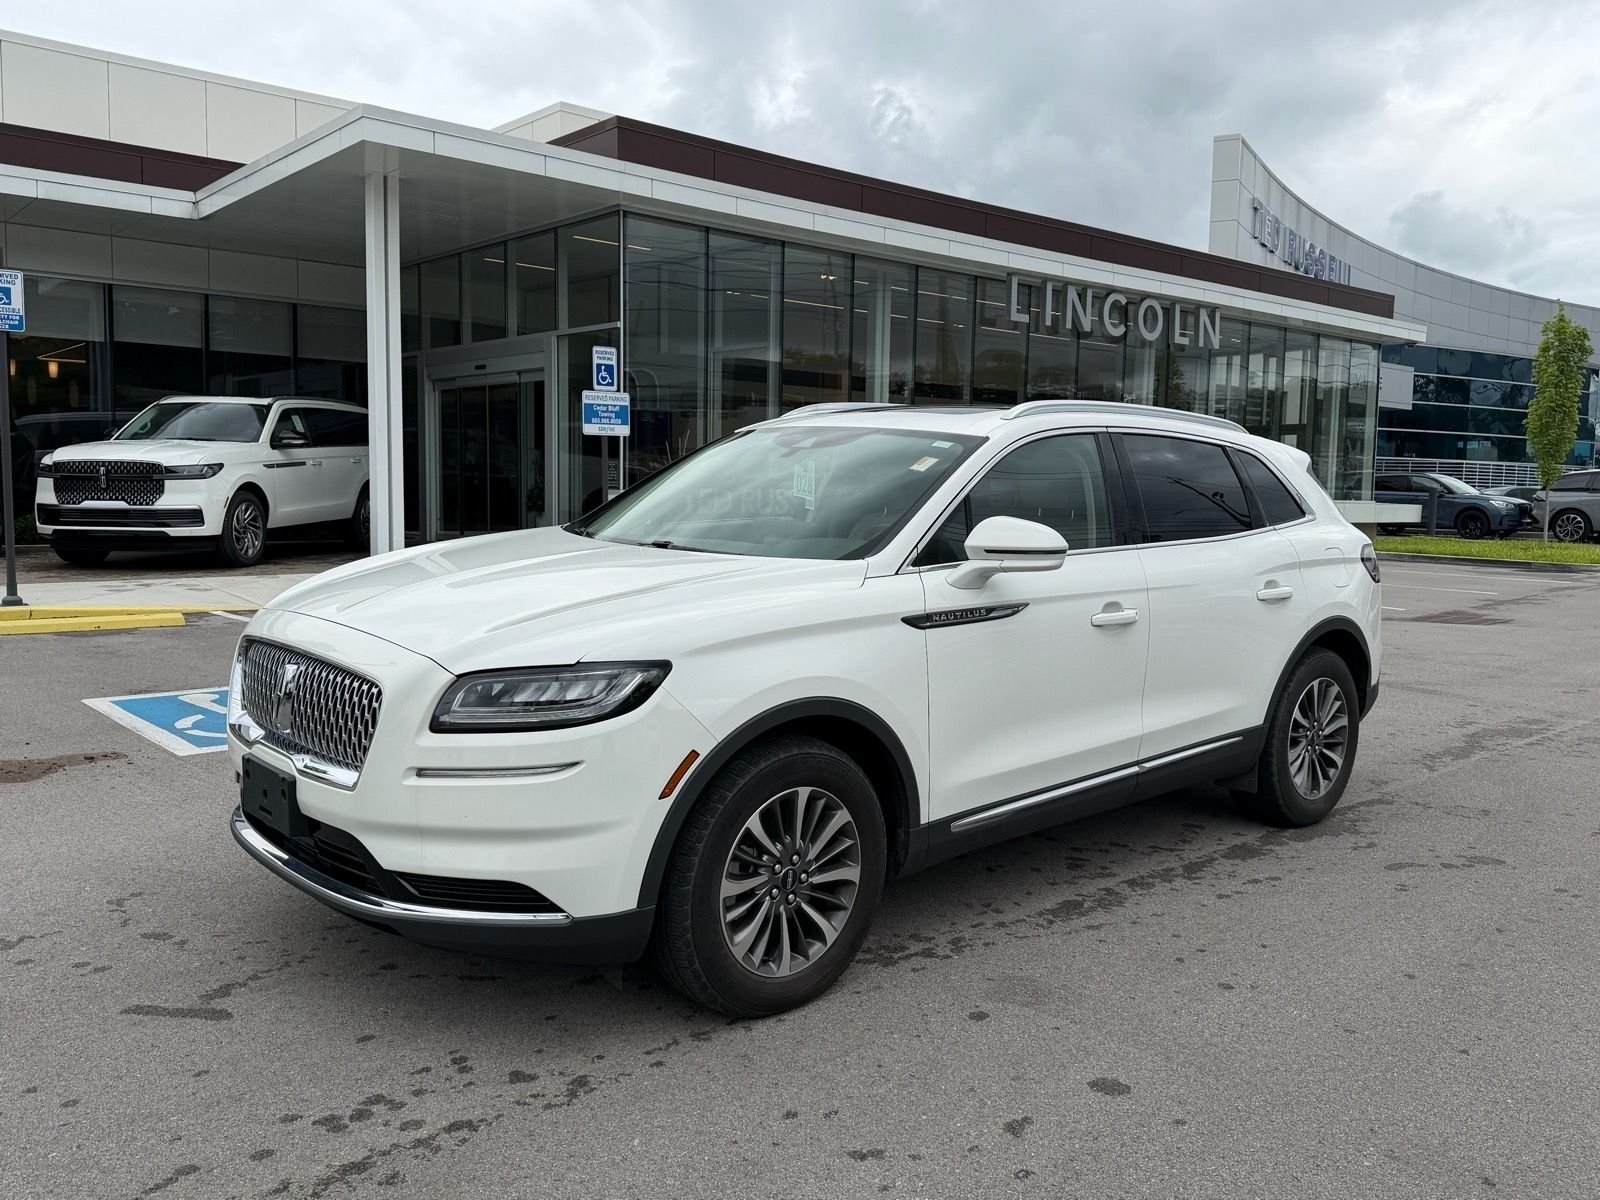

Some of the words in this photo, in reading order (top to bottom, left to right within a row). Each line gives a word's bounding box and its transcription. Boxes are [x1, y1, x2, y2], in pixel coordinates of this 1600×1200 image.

[1253, 196, 1281, 255] TED
[1008, 273, 1221, 350] LINCOLN
[932, 609, 987, 622] NAUTILUS
